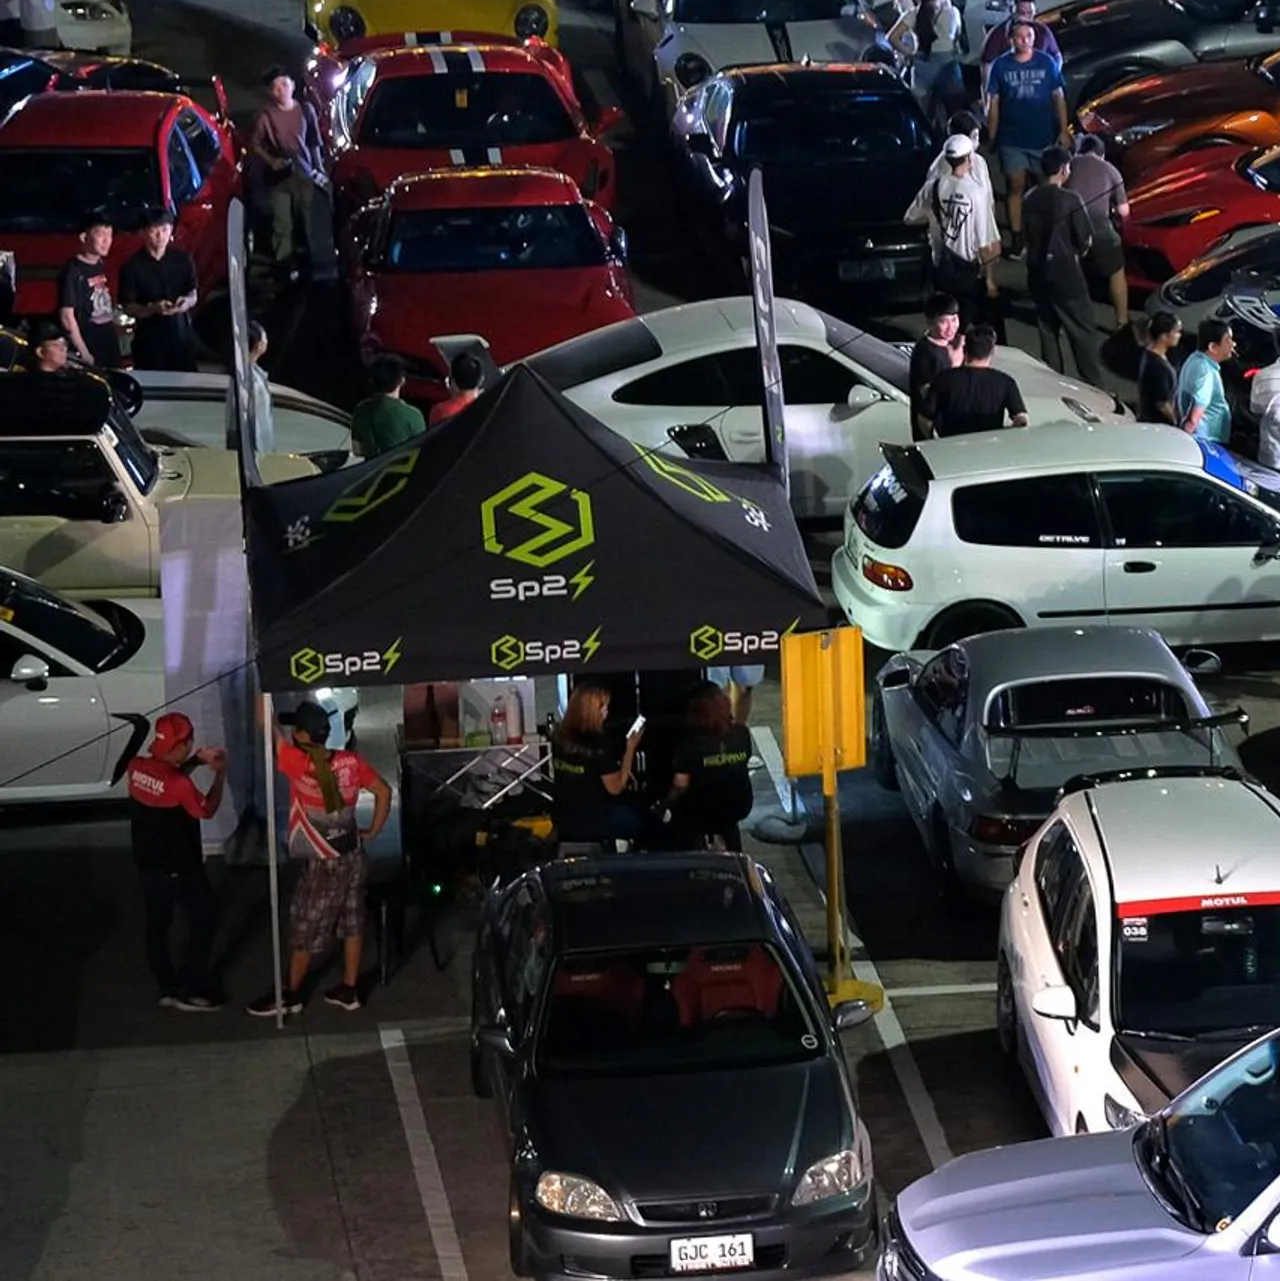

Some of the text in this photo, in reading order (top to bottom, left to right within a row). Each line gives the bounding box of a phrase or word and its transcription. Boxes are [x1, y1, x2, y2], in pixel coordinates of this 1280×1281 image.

[490, 575, 569, 601] Sp2
[525, 640, 581, 664] Sp2
[724, 631, 779, 655] Sp2
[326, 651, 381, 676] Sp2
[131, 770, 165, 794] MOTUL
[1200, 896, 1248, 908] MOTUL
[1123, 926, 1148, 937] 038
[678, 1241, 747, 1261] GJC 161
